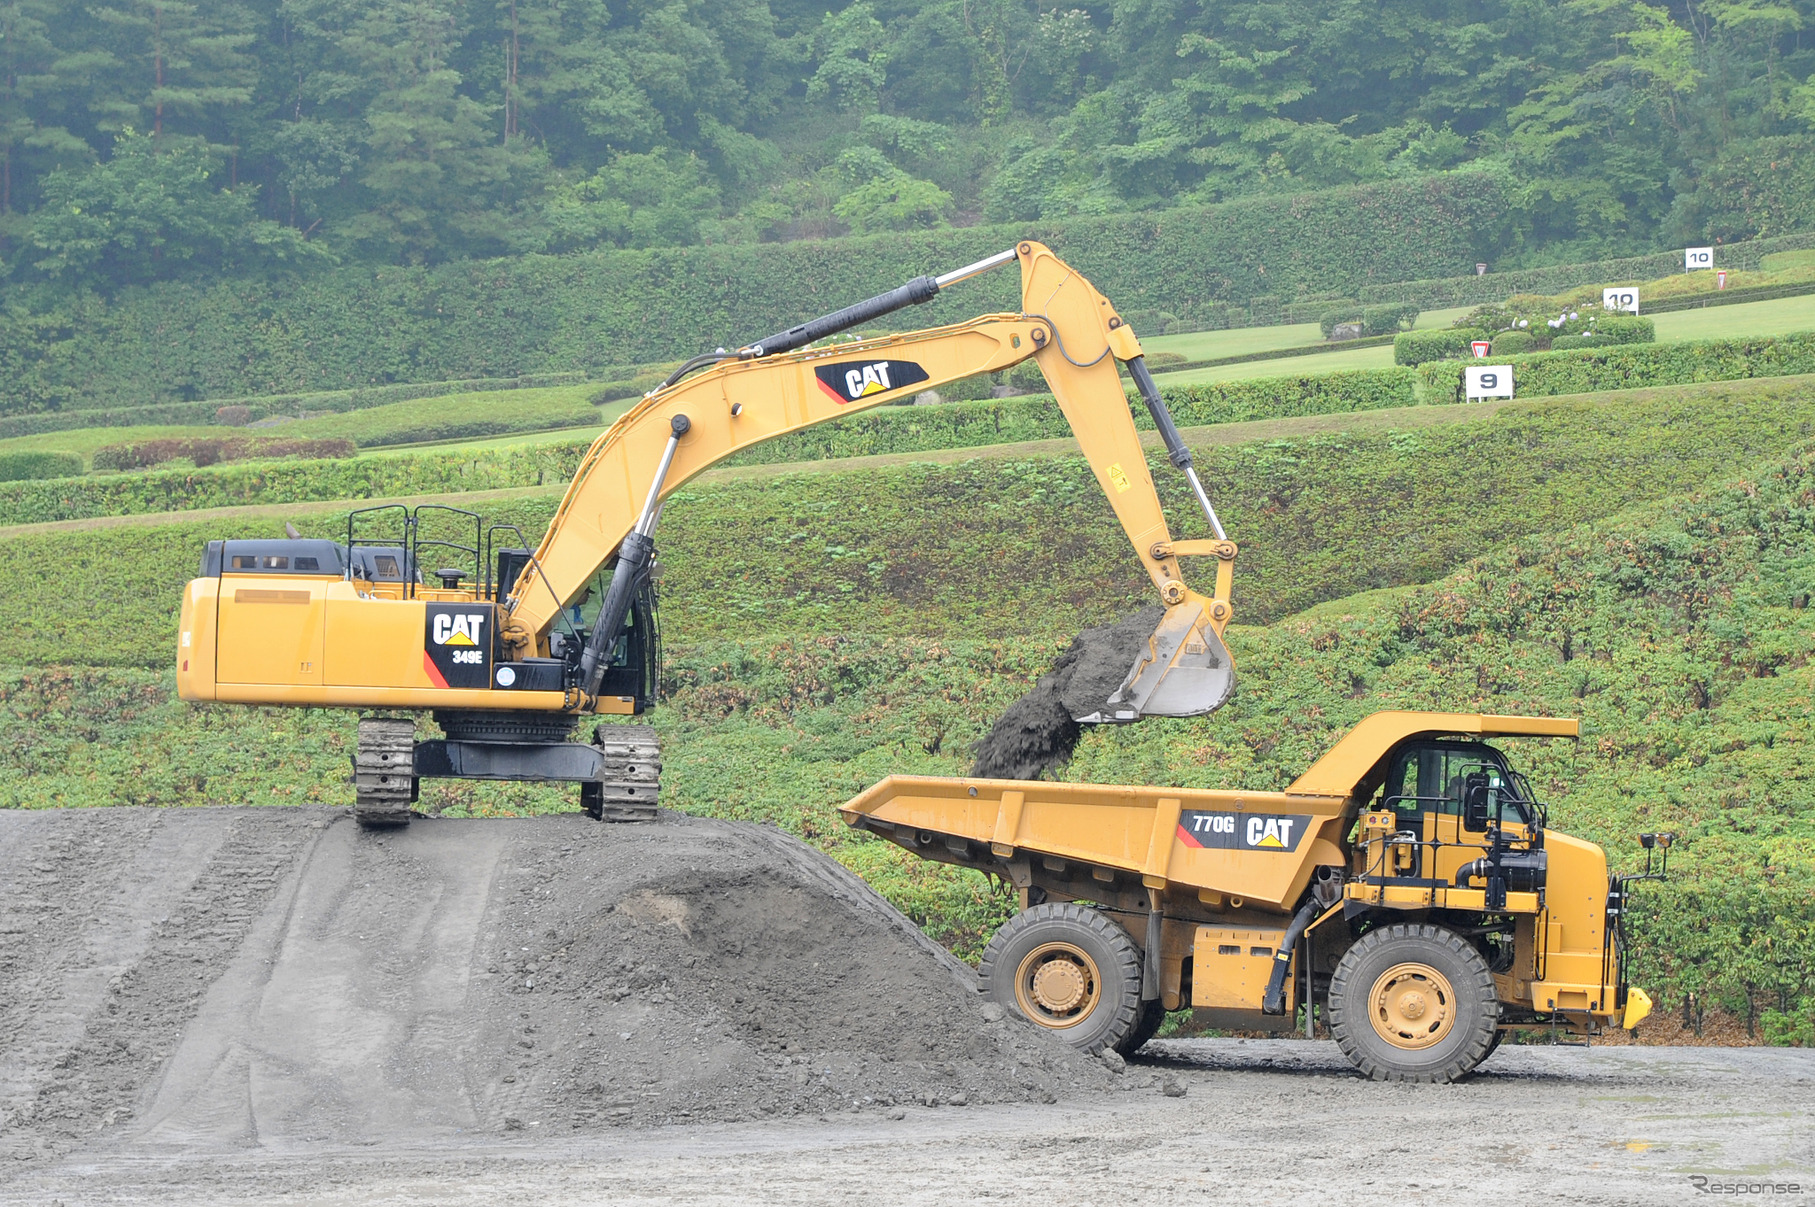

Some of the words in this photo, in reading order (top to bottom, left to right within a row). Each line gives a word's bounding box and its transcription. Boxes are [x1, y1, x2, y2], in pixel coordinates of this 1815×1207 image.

[1690, 253, 1709, 263] 10
[845, 361, 891, 398] CAT
[1480, 373, 1498, 389] 9
[433, 613, 484, 646] CAT
[452, 650, 483, 664] 349E
[1193, 815, 1235, 833] 770G
[1246, 817, 1293, 848] CAT
